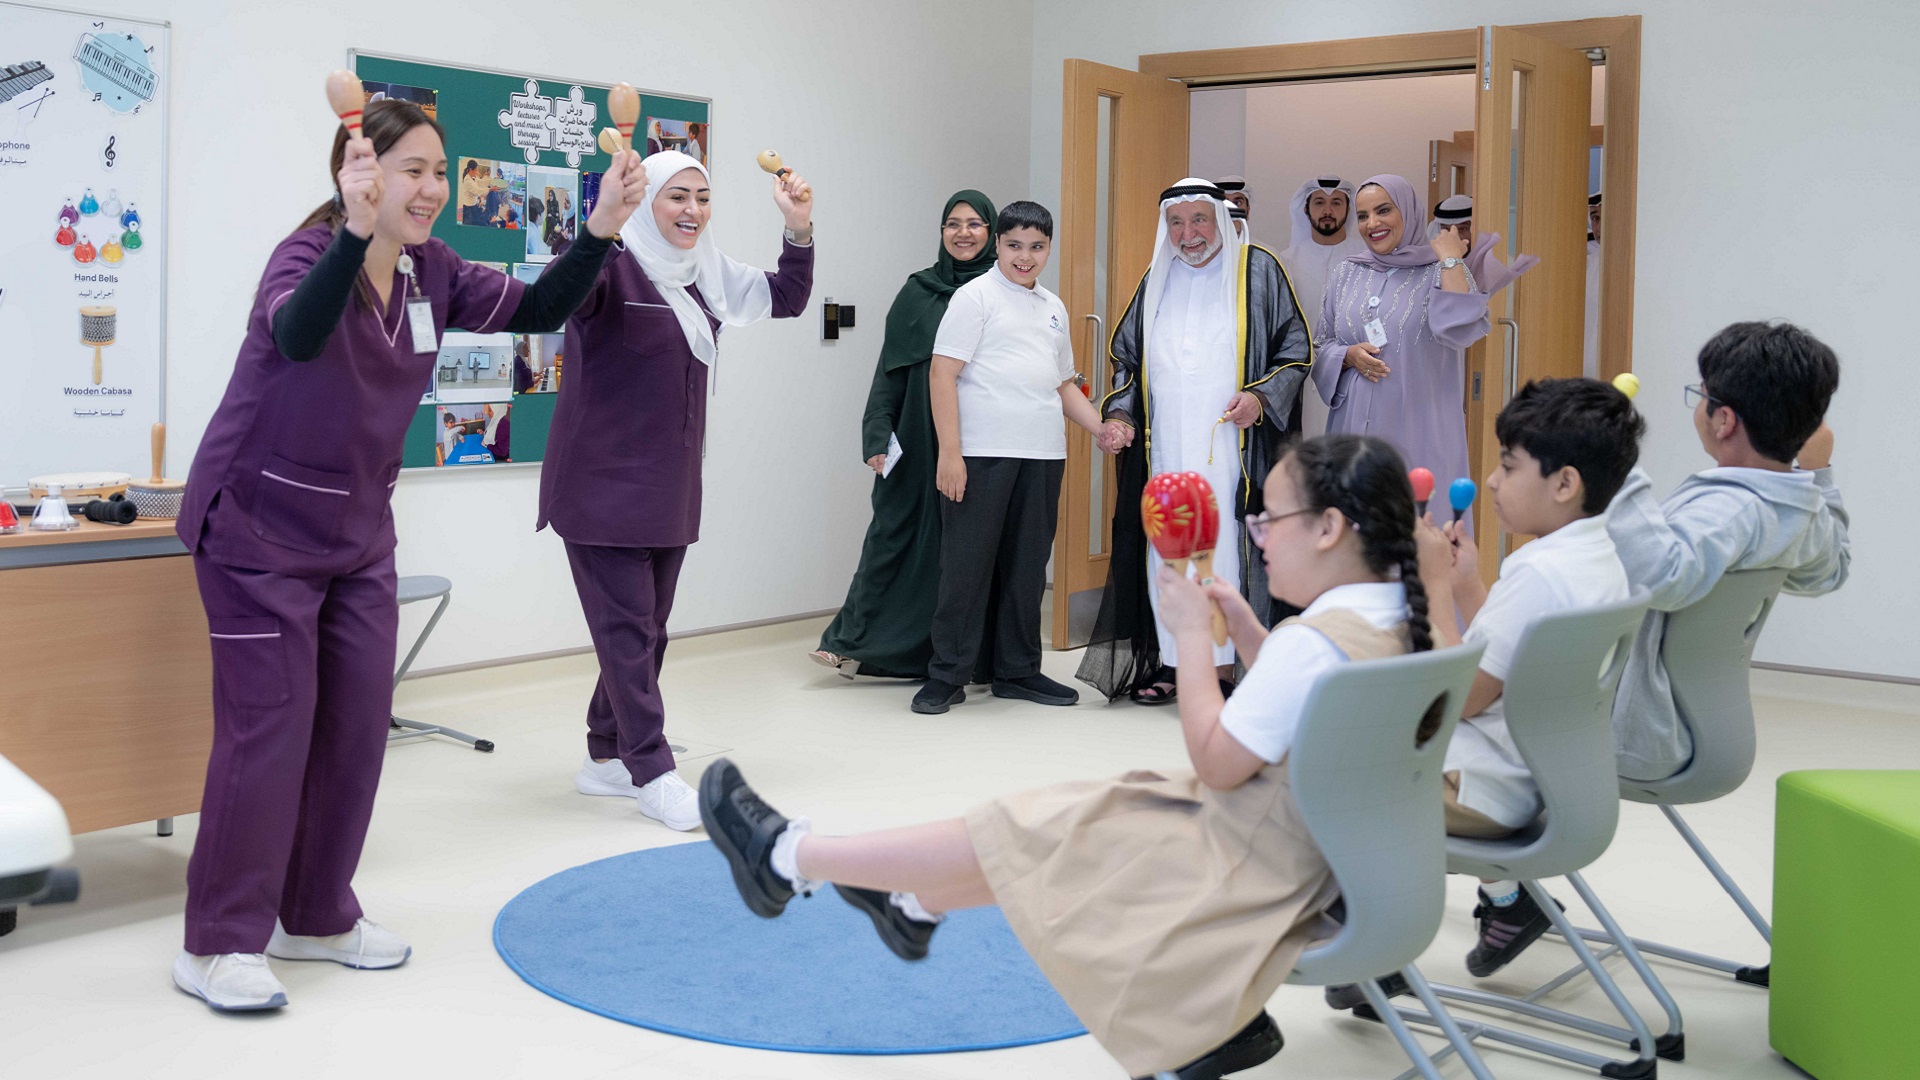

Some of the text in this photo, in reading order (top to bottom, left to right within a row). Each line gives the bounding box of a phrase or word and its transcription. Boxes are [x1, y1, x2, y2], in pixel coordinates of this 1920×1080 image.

[513, 100, 546, 112] Workshops,
[566, 104, 583, 117] ورش
[517, 110, 540, 120] lectures
[526, 122, 543, 130] music
[559, 116, 588, 126] محاضرات
[517, 129, 540, 140] therapy
[563, 128, 584, 139] جلسات
[518, 139, 540, 147] sessions
[74, 273, 119, 283] Hand Bells
[63, 387, 133, 396] Wooden Cabasa
